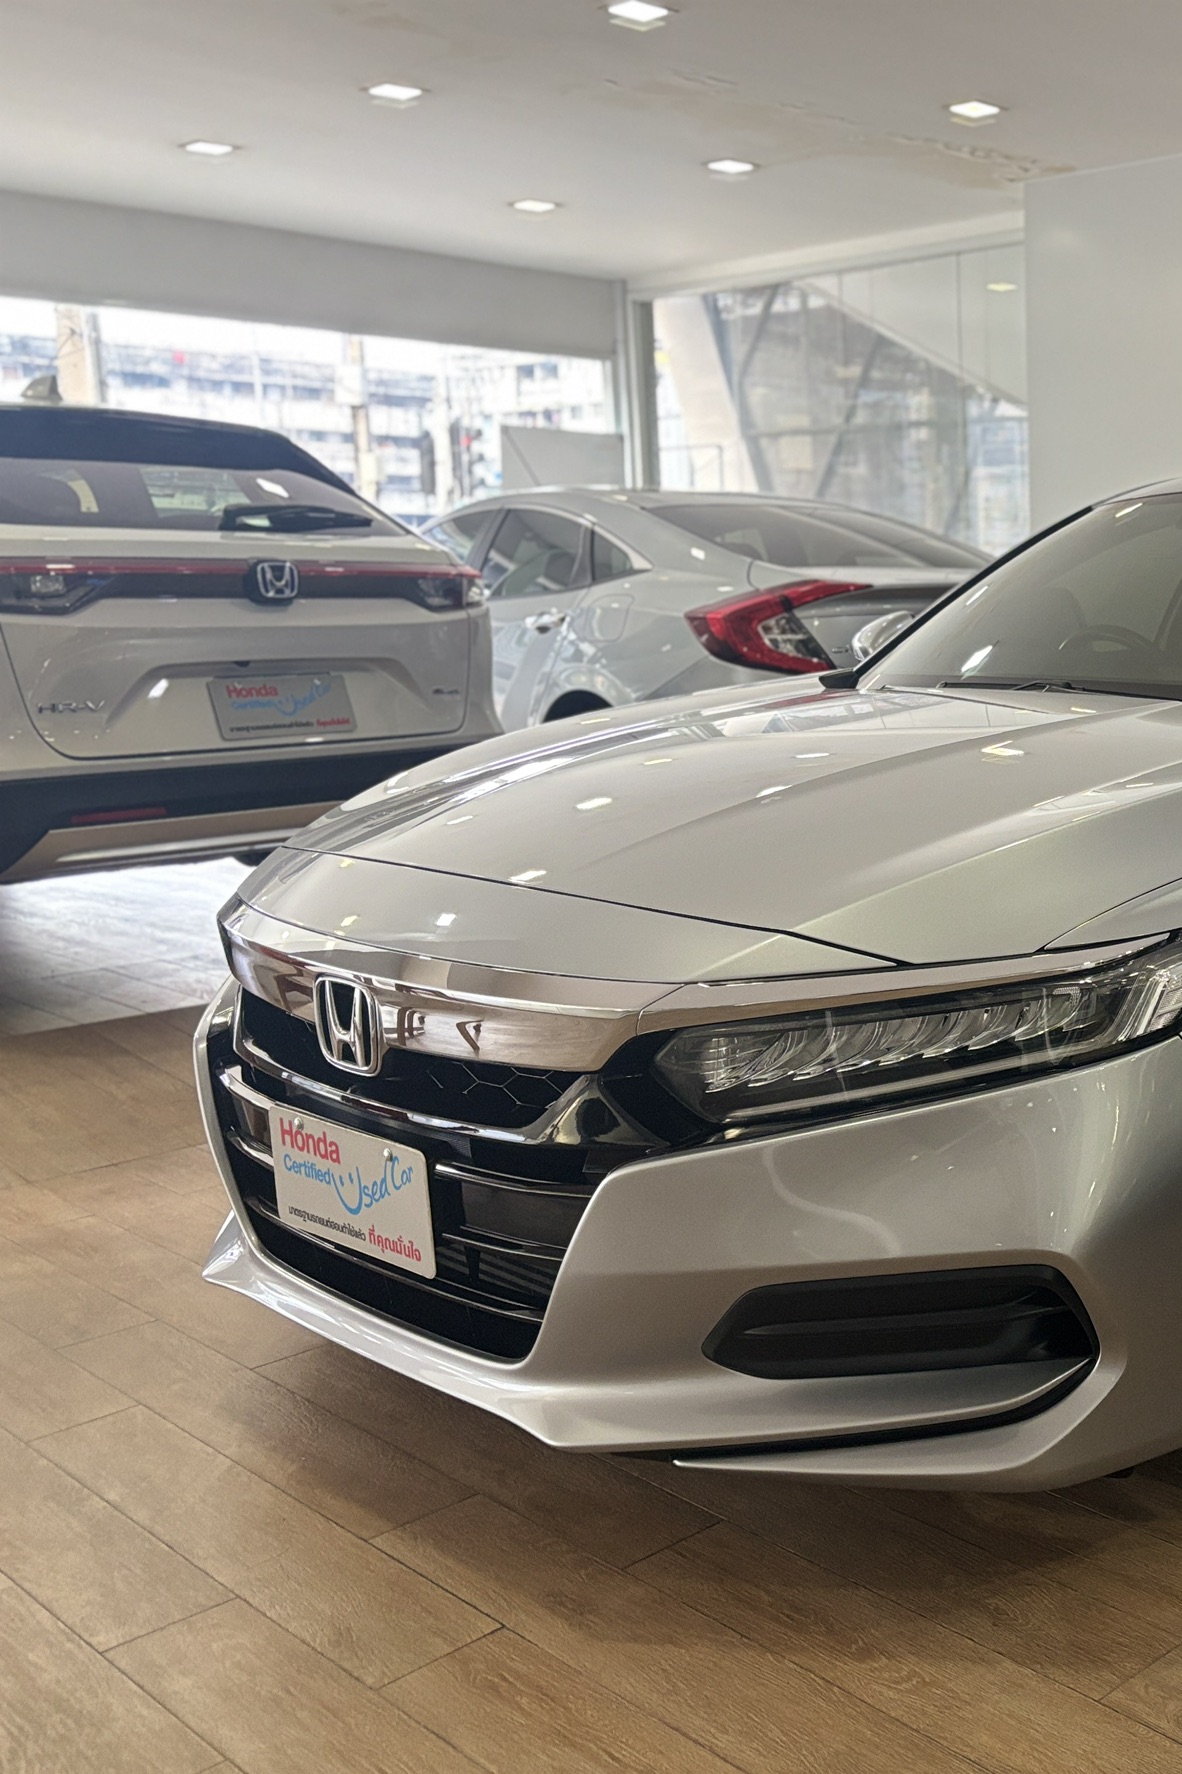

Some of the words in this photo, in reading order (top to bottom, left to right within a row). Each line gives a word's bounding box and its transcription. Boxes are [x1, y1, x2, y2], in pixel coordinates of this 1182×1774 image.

[37, 699, 106, 714] HR-V
[225, 684, 279, 699] Honda
[278, 1117, 341, 1165] Honda
[283, 1153, 332, 1186] Certified
[331, 1158, 391, 1216] Used
[391, 1155, 414, 1191] Car
[368, 1224, 422, 1263] ที่คุณมั่นใจ
